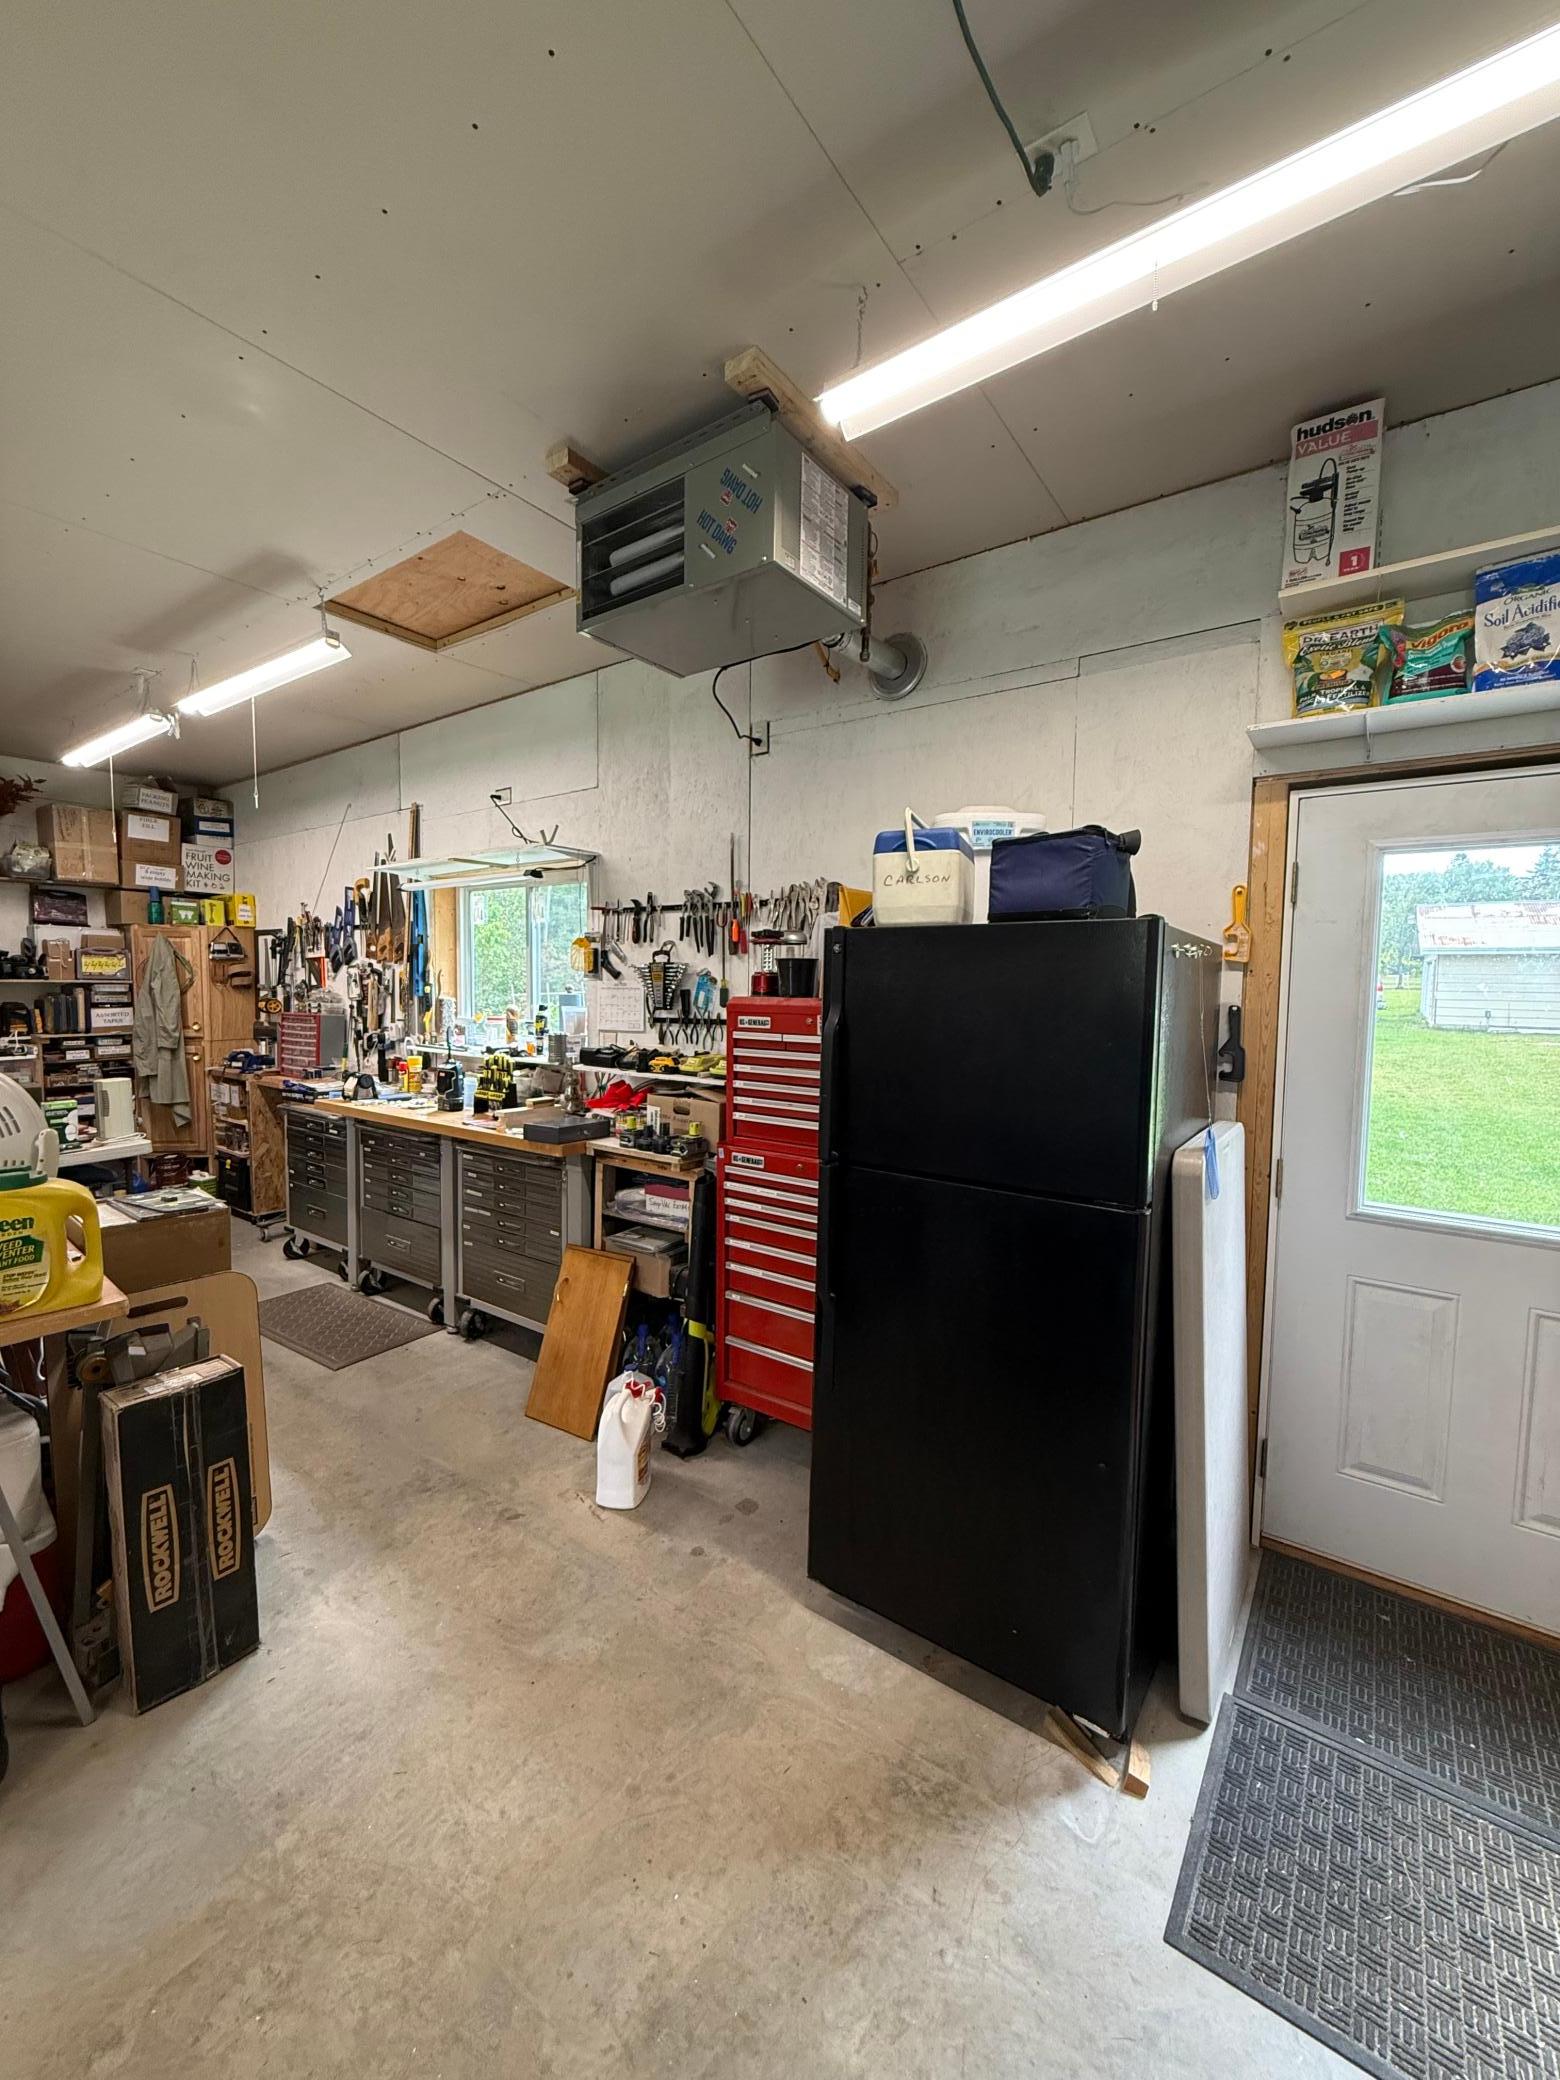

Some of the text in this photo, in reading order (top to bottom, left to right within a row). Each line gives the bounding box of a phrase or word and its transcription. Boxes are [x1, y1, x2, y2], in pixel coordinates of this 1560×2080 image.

[1297, 410, 1373, 442] hudson
[1298, 430, 1352, 456] VALUE
[720, 467, 763, 514] HOT DAWG
[696, 509, 737, 554] HOT DAWG
[1503, 587, 1551, 605] ORGANIC
[1484, 608, 1509, 627] Soil
[1330, 623, 1379, 642] EARTH
[185, 861, 215, 872] WINE
[186, 852, 213, 863] FRUIT
[186, 870, 231, 882] MAKING
[186, 879, 201, 888] KIT
[883, 874, 951, 887] CARLSON
[0, 1216, 35, 1232] een
[14, 1254, 35, 1264] FOOD
[214, 1465, 235, 1572] ROCKWELL
[149, 1493, 173, 1601] ROCKWELL
